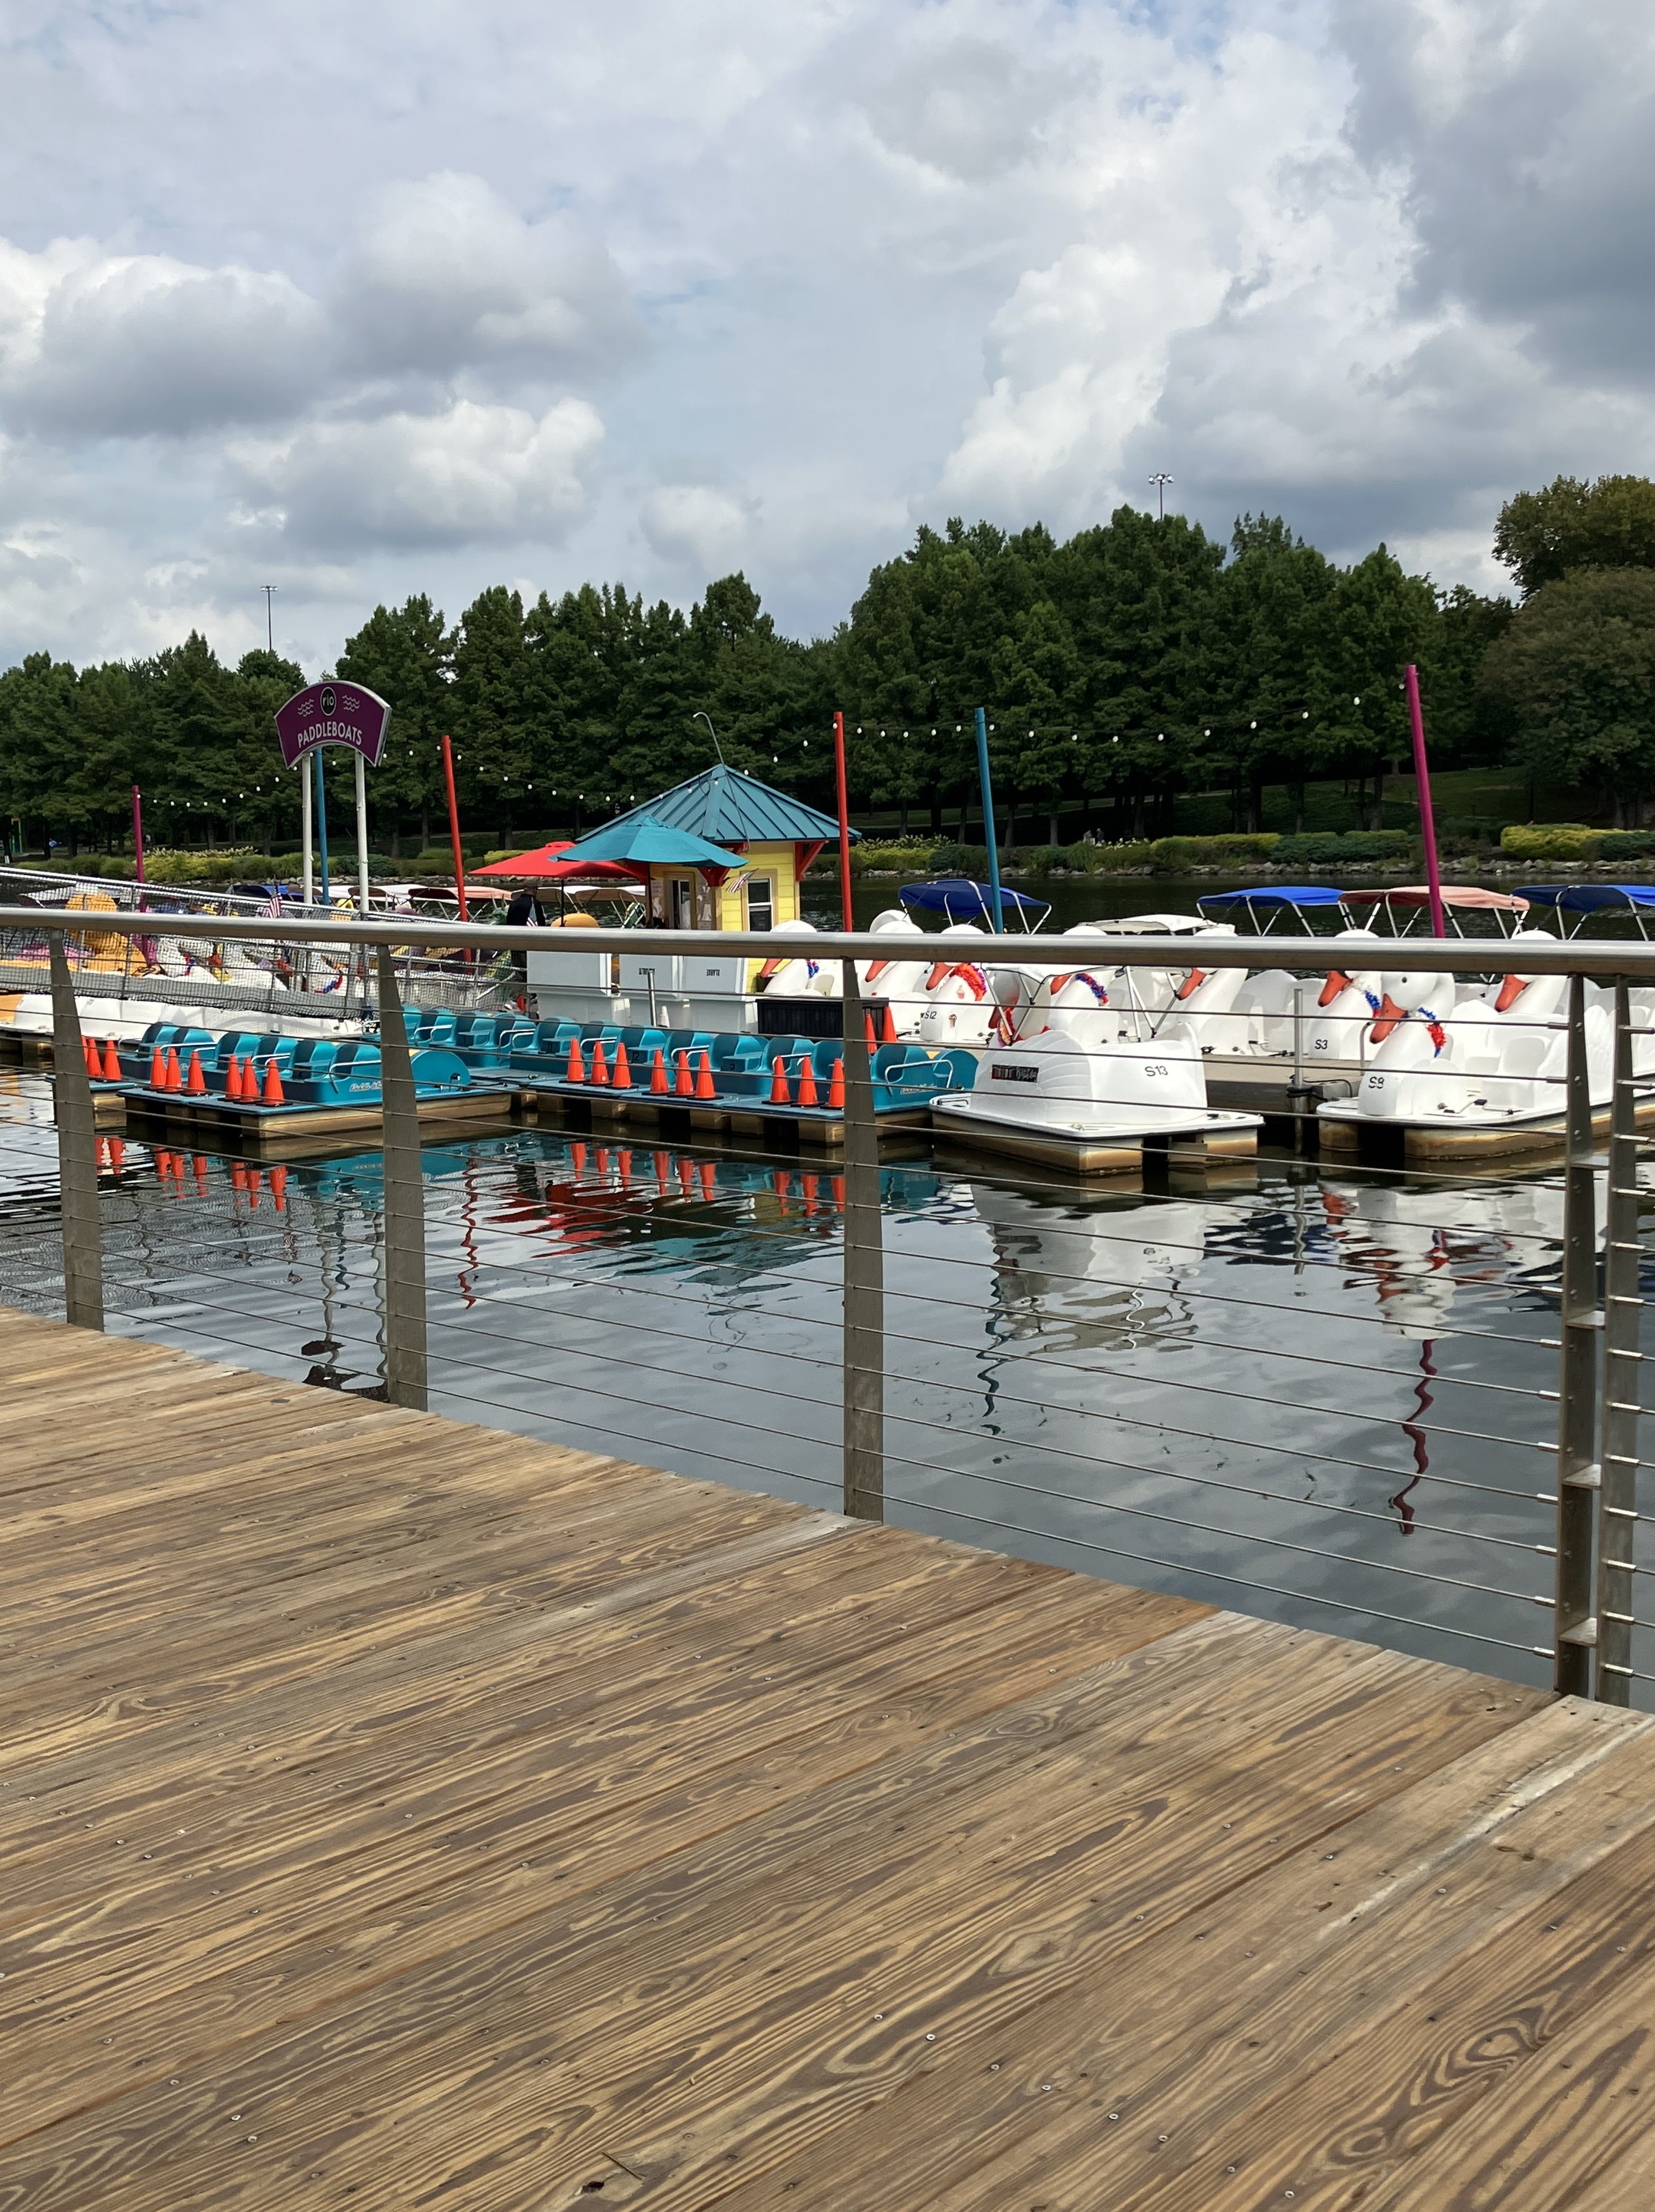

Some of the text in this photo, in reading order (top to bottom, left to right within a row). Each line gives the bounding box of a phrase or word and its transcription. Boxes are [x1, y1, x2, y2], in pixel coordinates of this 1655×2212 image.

[297, 721, 362, 748] PADDLEBOATS
[924, 1010, 937, 1019] S12
[1314, 1039, 1328, 1050] S3
[1145, 1066, 1168, 1077] S13
